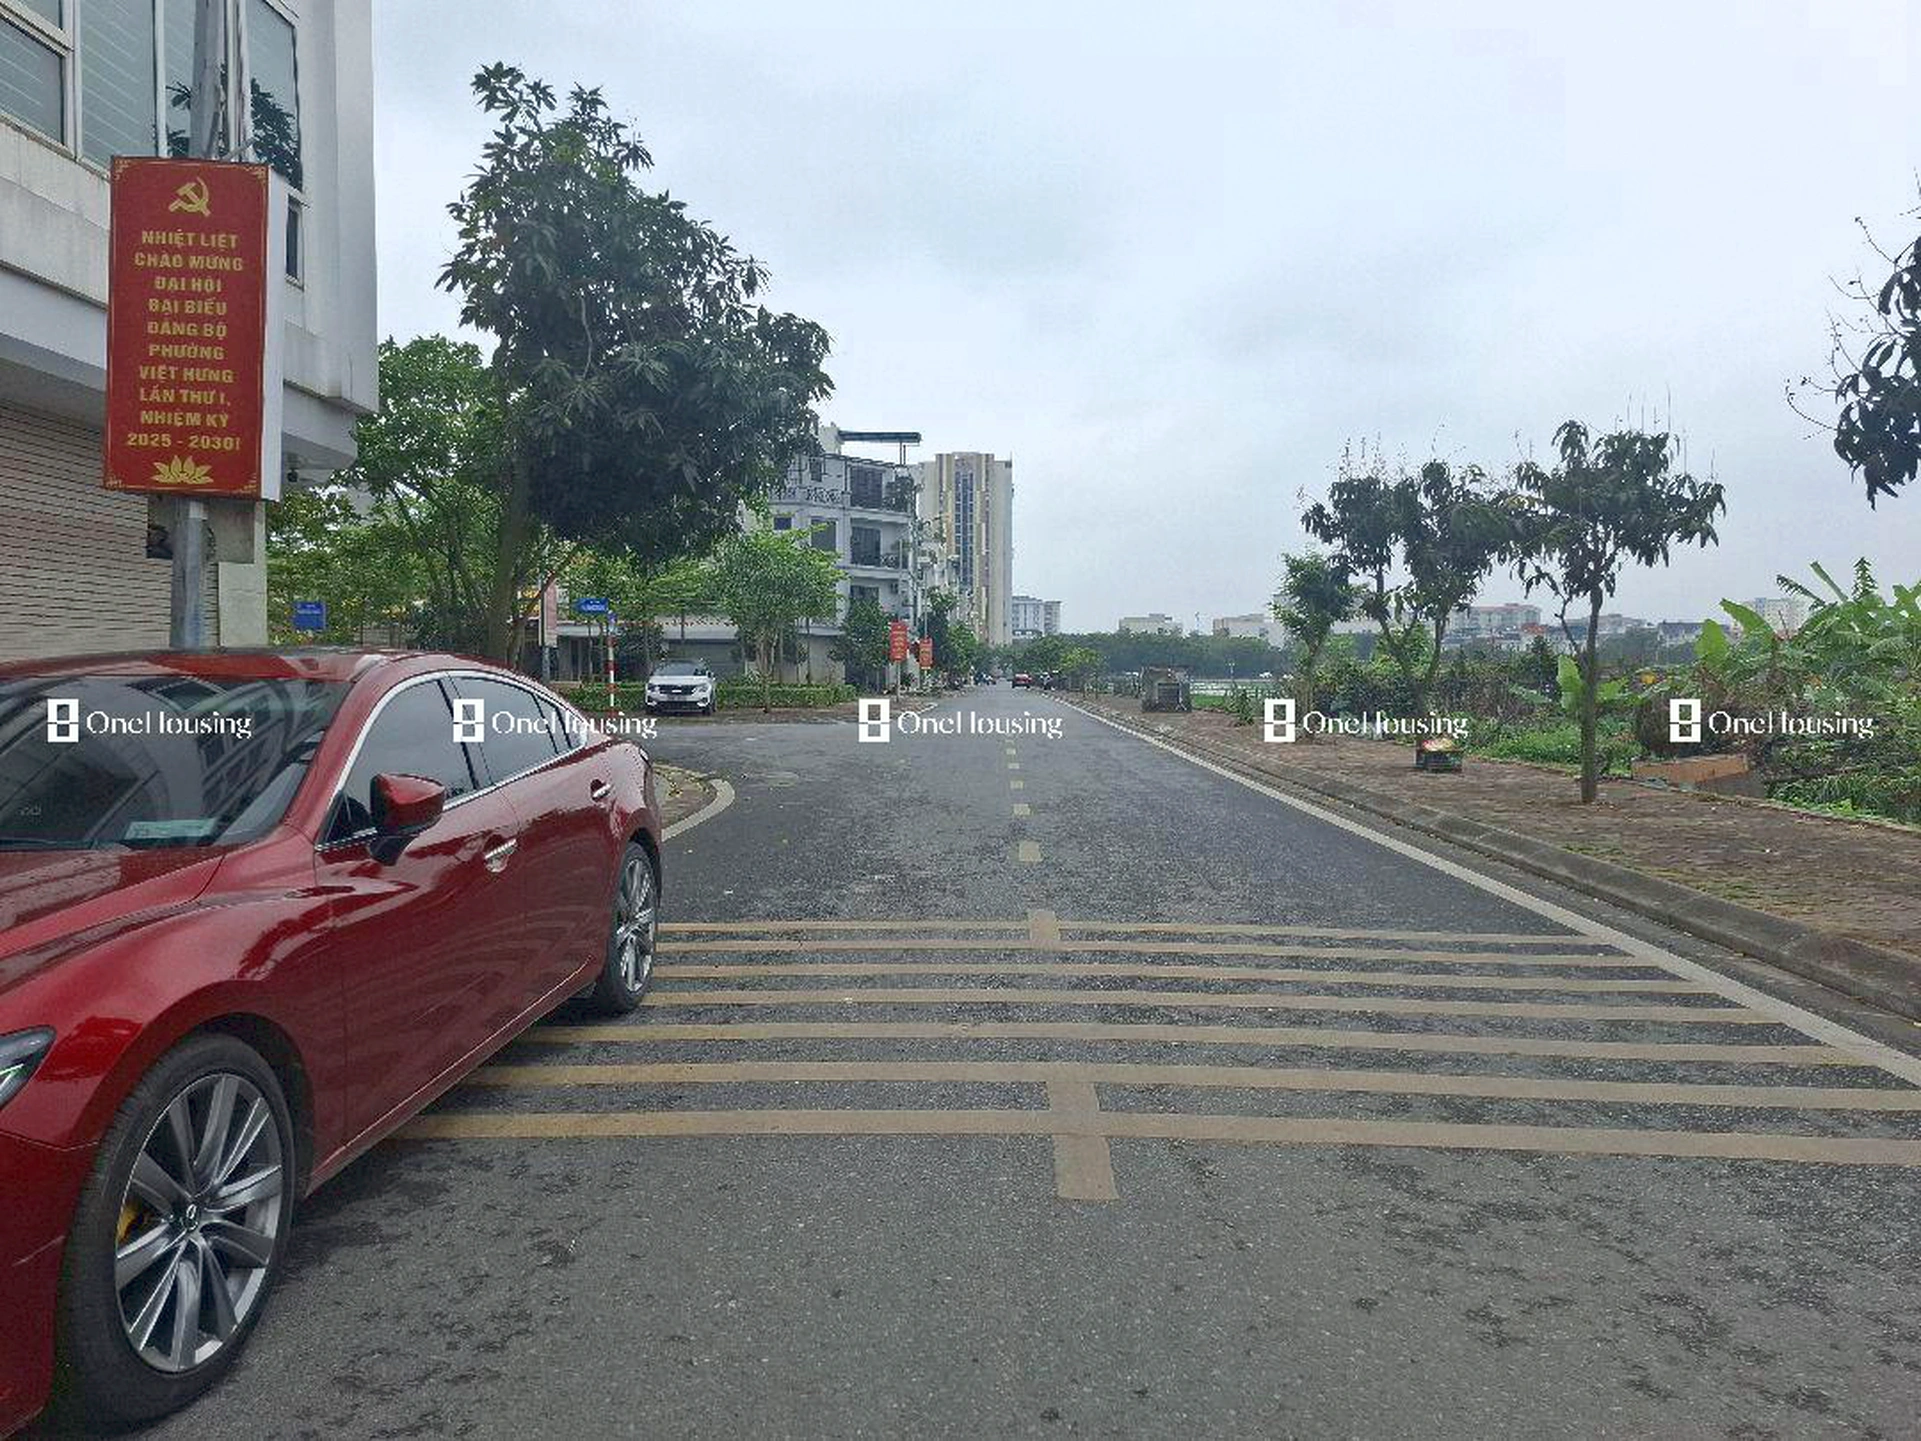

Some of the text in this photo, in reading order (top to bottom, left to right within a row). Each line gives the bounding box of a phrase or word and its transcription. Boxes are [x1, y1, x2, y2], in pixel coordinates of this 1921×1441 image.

[201, 232, 239, 251] LIỆT
[203, 321, 228, 340] BỘ
[140, 364, 178, 383] VIỆT
[127, 433, 172, 447] 2025
